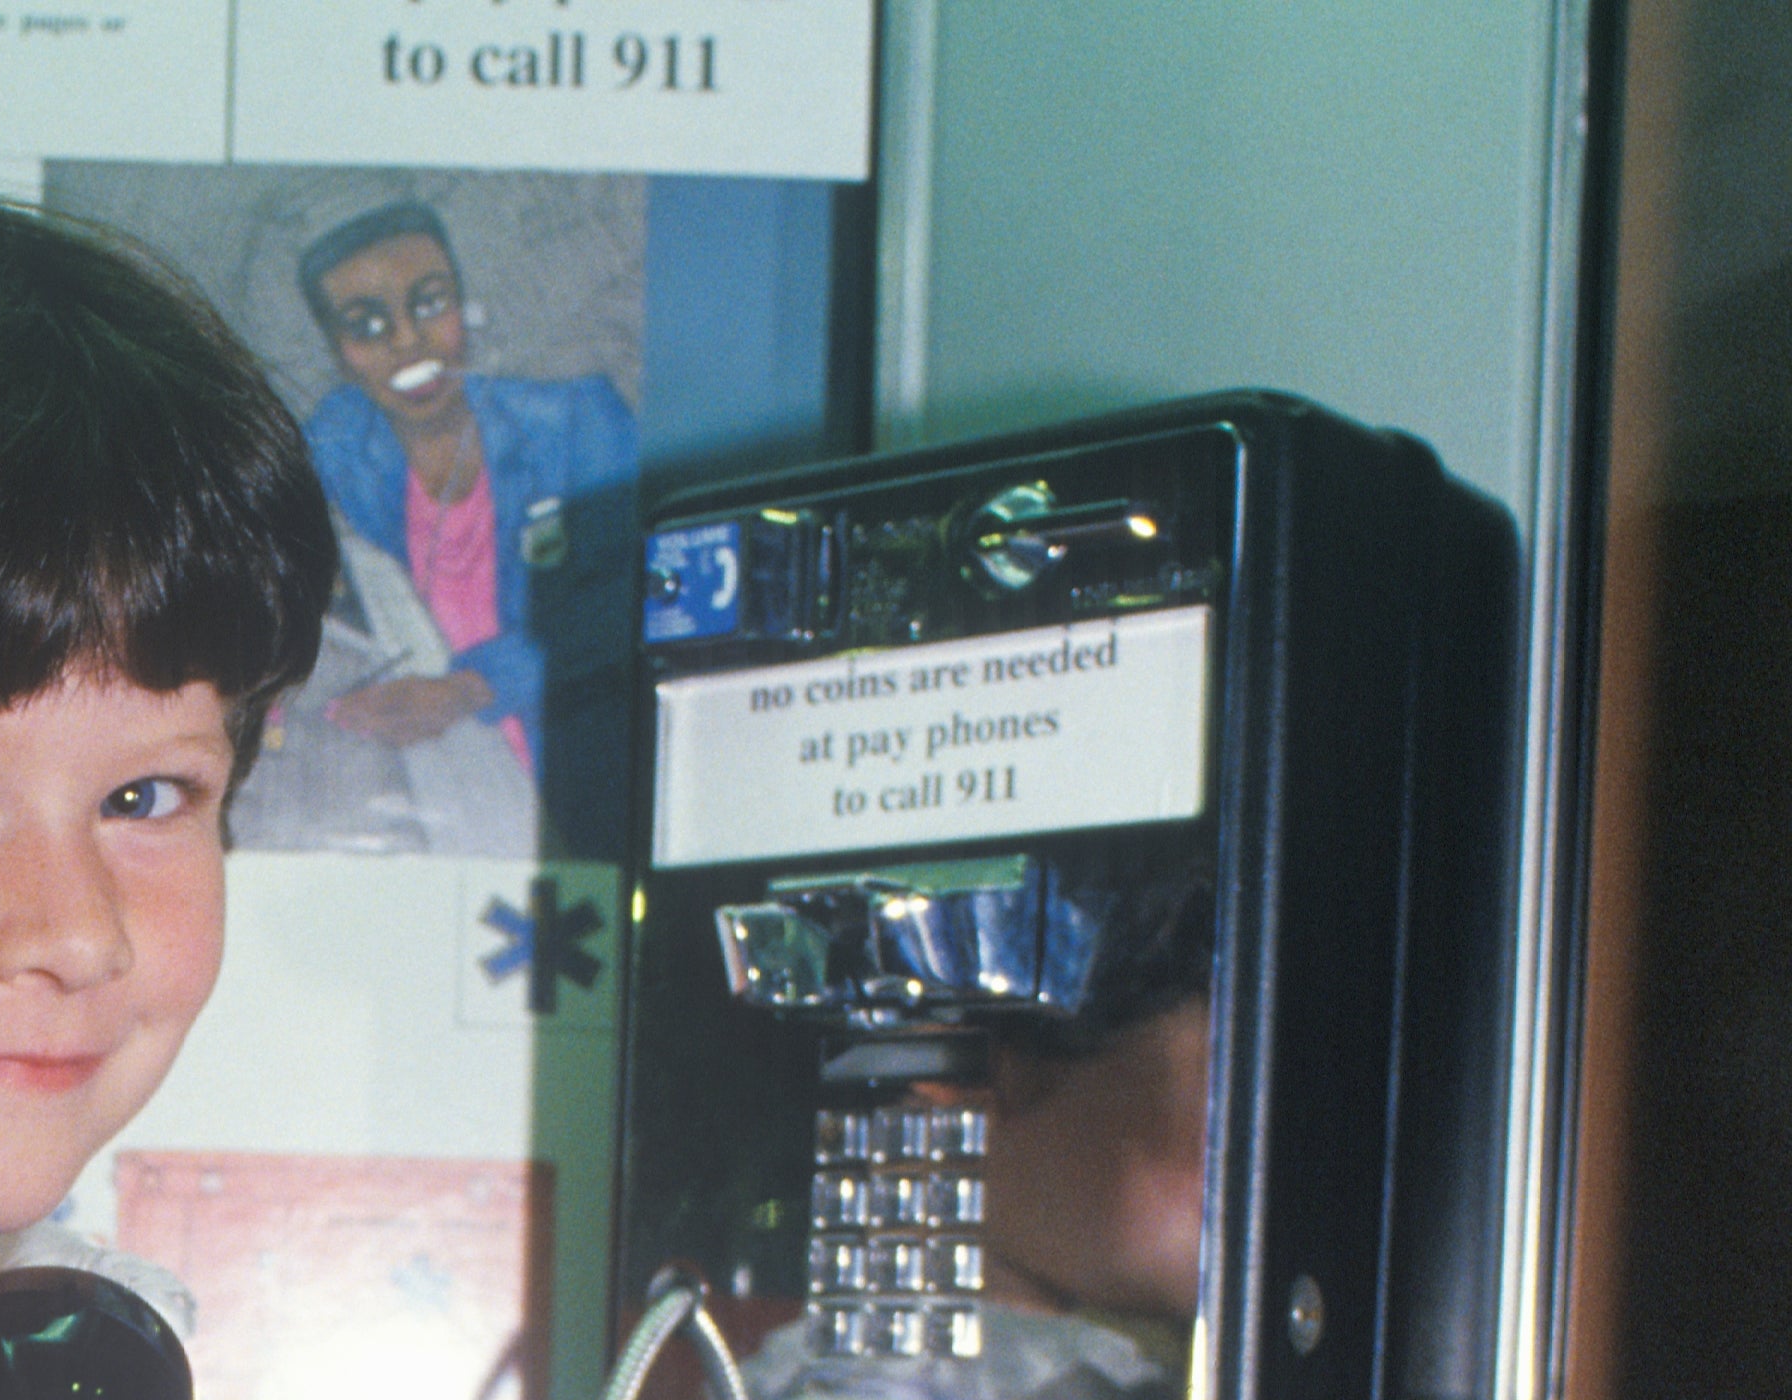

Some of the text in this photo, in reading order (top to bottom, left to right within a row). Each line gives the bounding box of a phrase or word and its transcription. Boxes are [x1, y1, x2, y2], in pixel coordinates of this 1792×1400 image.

[383, 32, 719, 92] to call 911
[749, 633, 1118, 711] no coins are needed
[798, 708, 1060, 768] at pay phones
[832, 765, 1017, 817] to call 911
